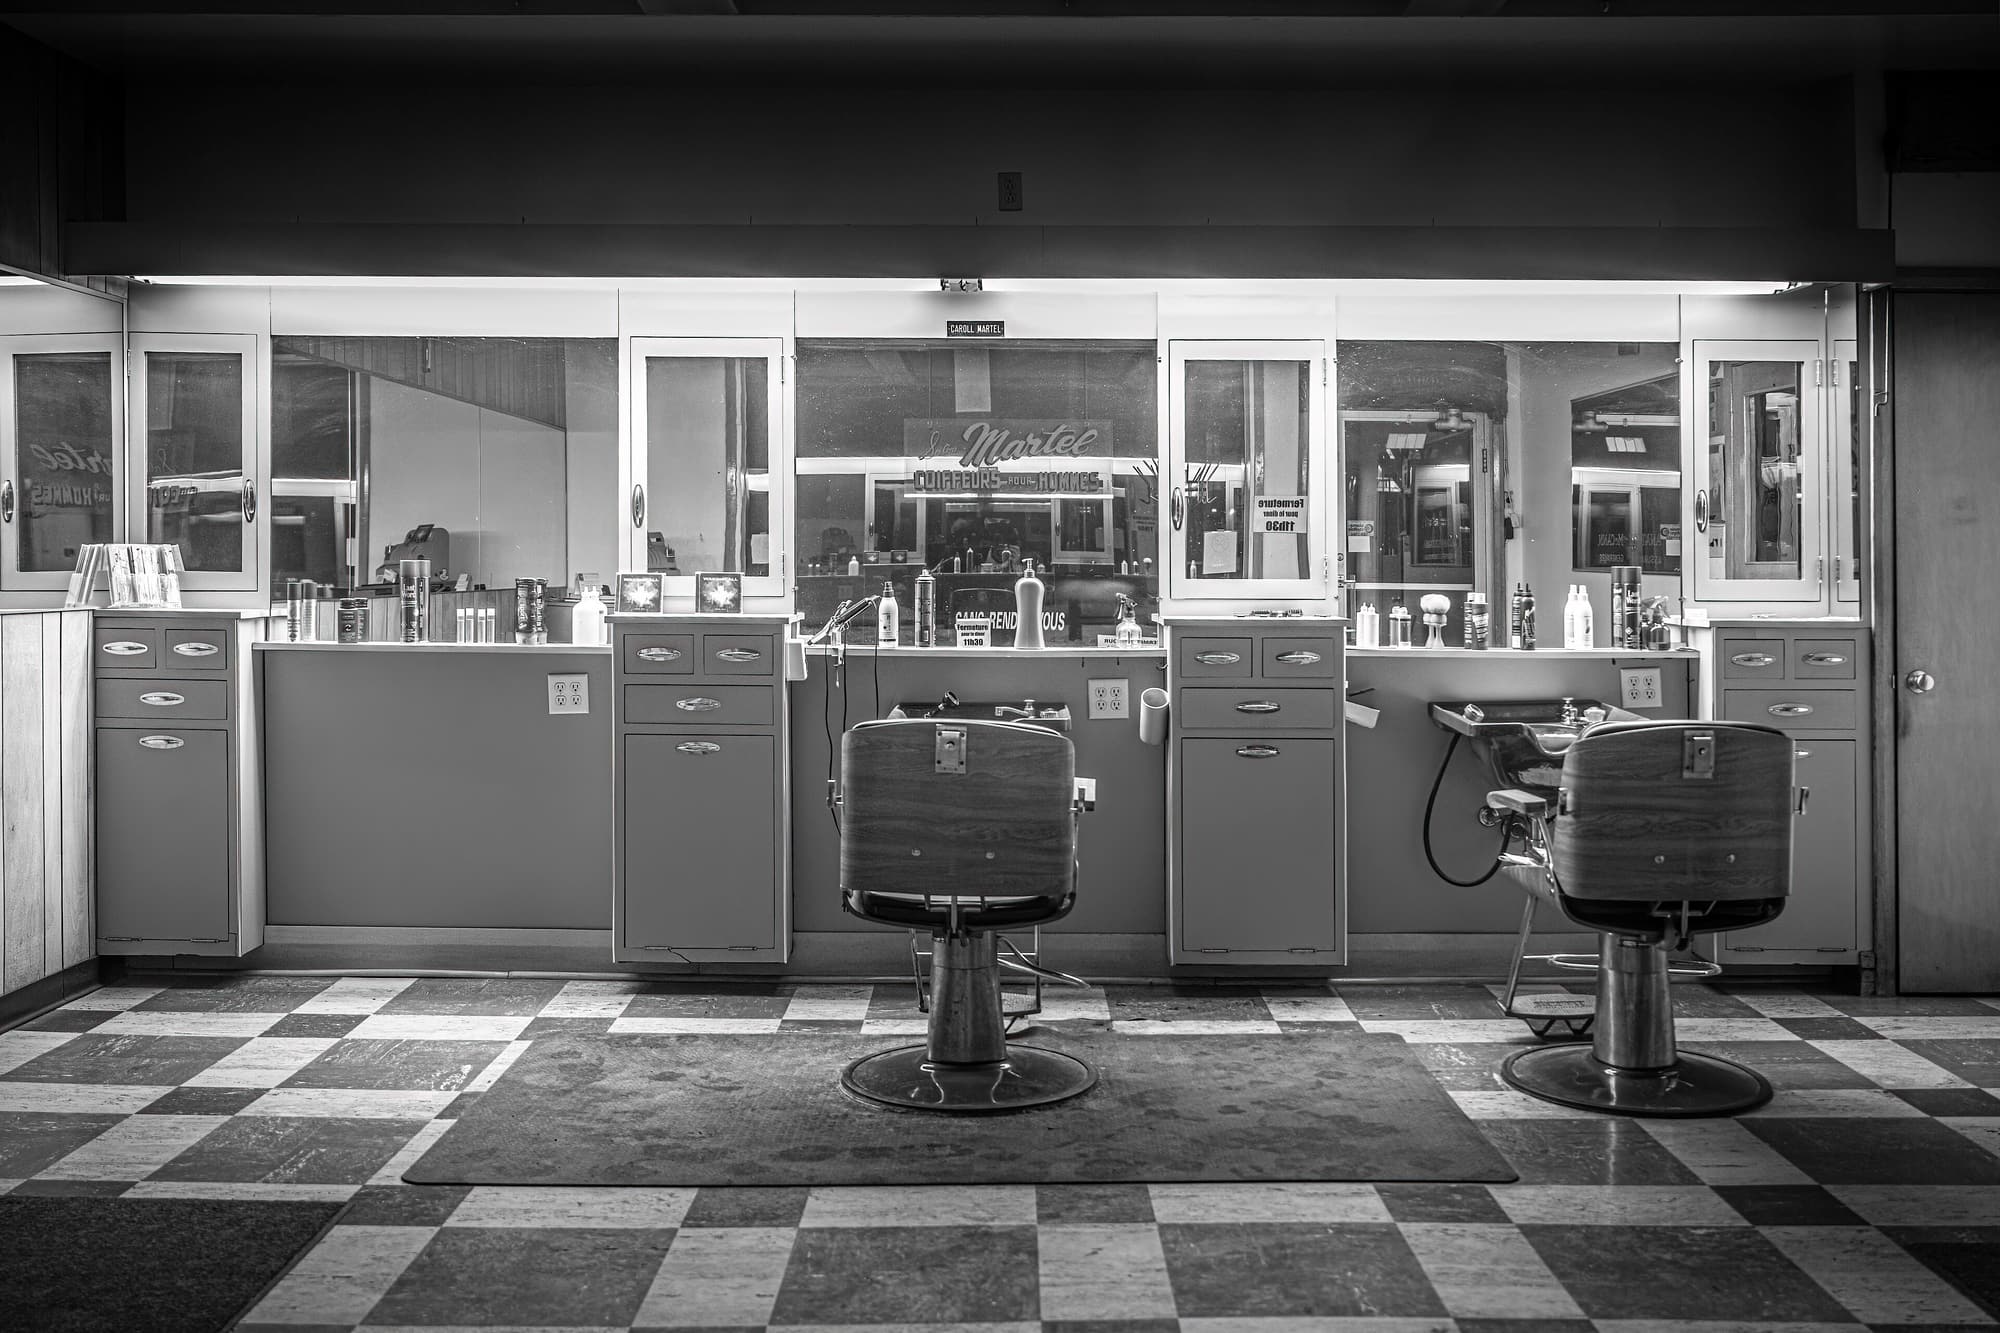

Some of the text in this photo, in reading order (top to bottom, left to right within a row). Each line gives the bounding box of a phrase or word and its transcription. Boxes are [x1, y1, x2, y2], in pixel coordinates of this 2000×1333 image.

[950, 324, 1001, 334] CAROLL MARTEL
[959, 422, 1098, 467] Martel
[914, 470, 1000, 490] COIFFEURS
[1039, 471, 1099, 491] HOMMES
[963, 638, 983, 646] 11h30
